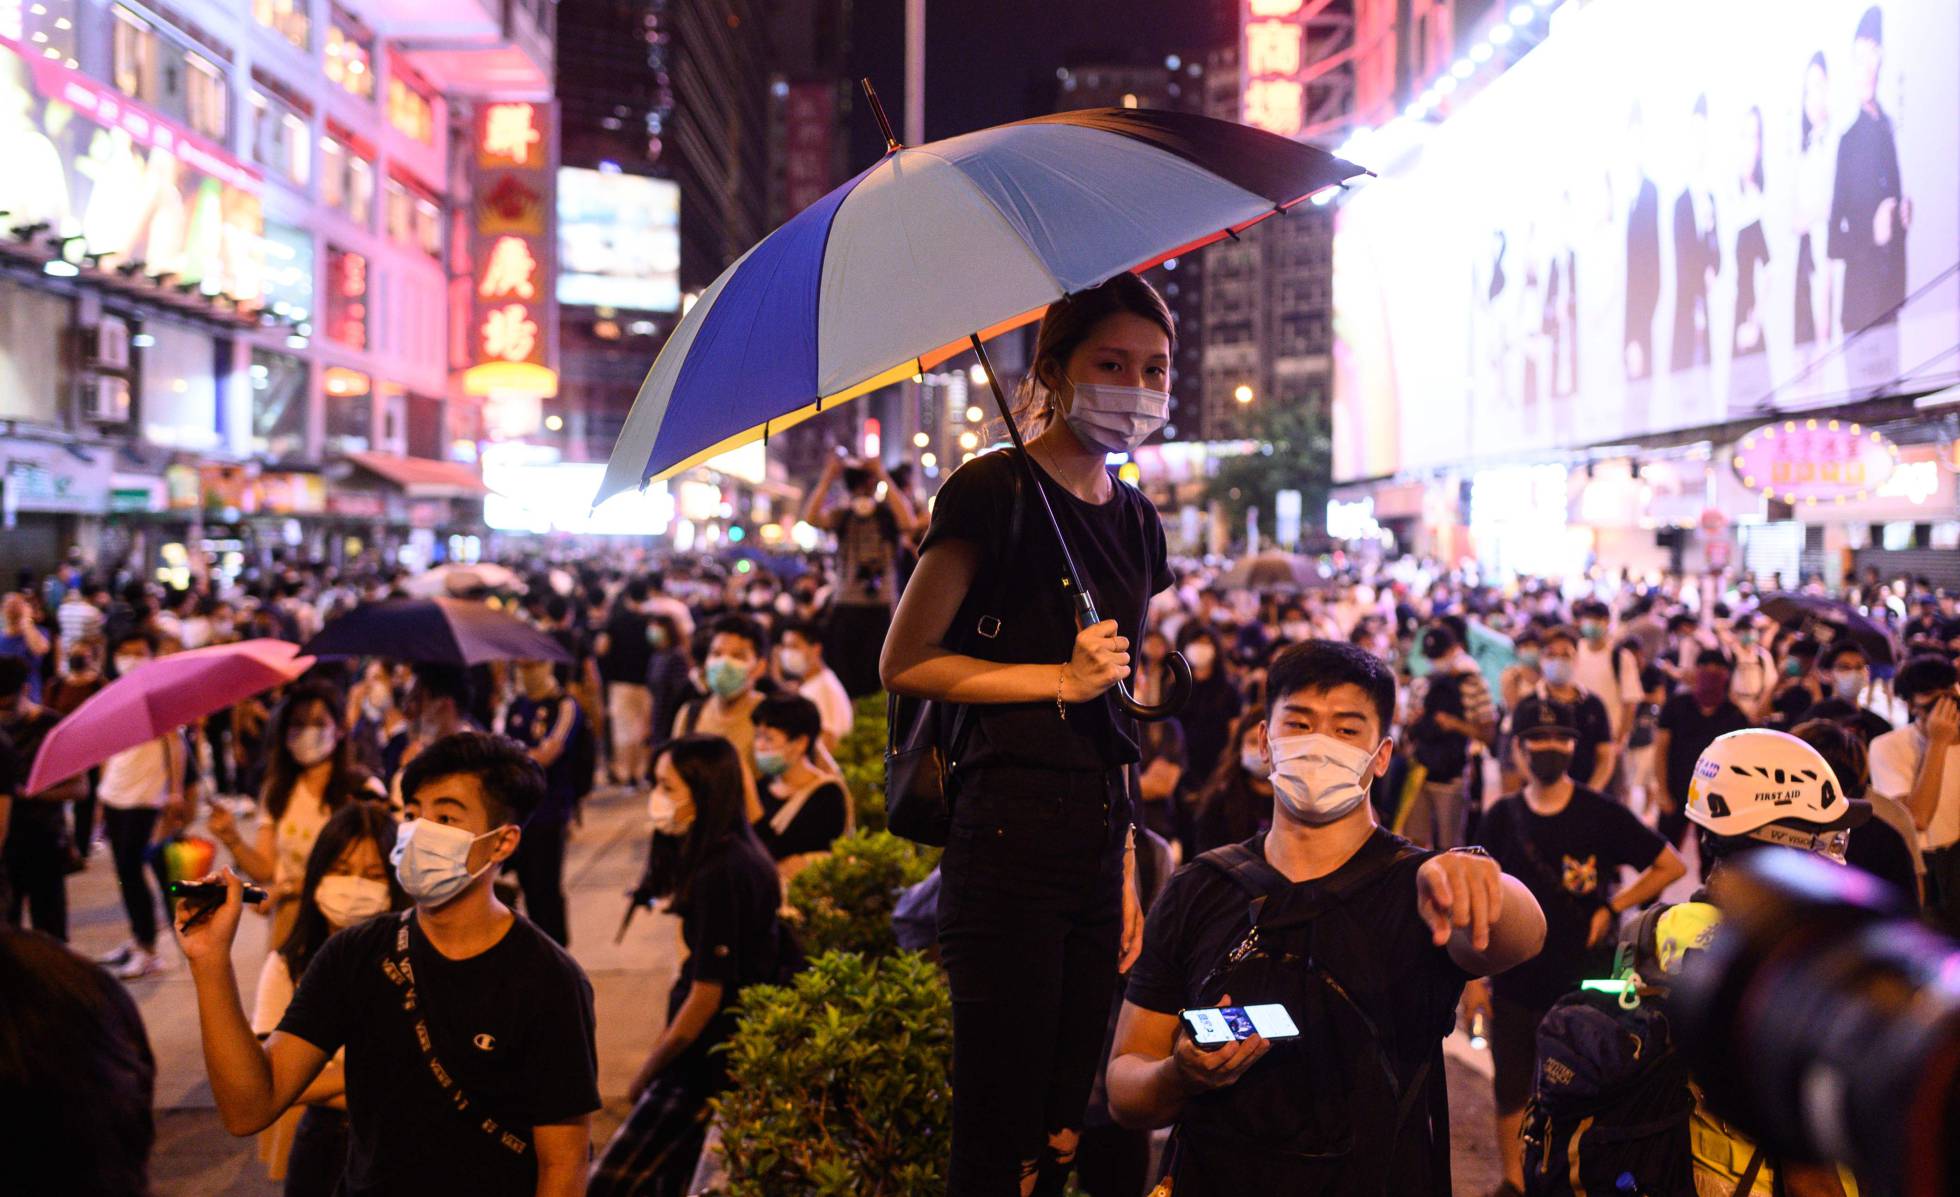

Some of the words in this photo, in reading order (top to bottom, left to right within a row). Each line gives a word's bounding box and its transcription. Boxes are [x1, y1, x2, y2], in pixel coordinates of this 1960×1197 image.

[1754, 791, 1783, 802] FIRST
[1784, 789, 1801, 800] AID
[415, 1019, 432, 1053] VANS
[430, 1057, 453, 1089] VANS
[501, 1132, 528, 1155] VANS
